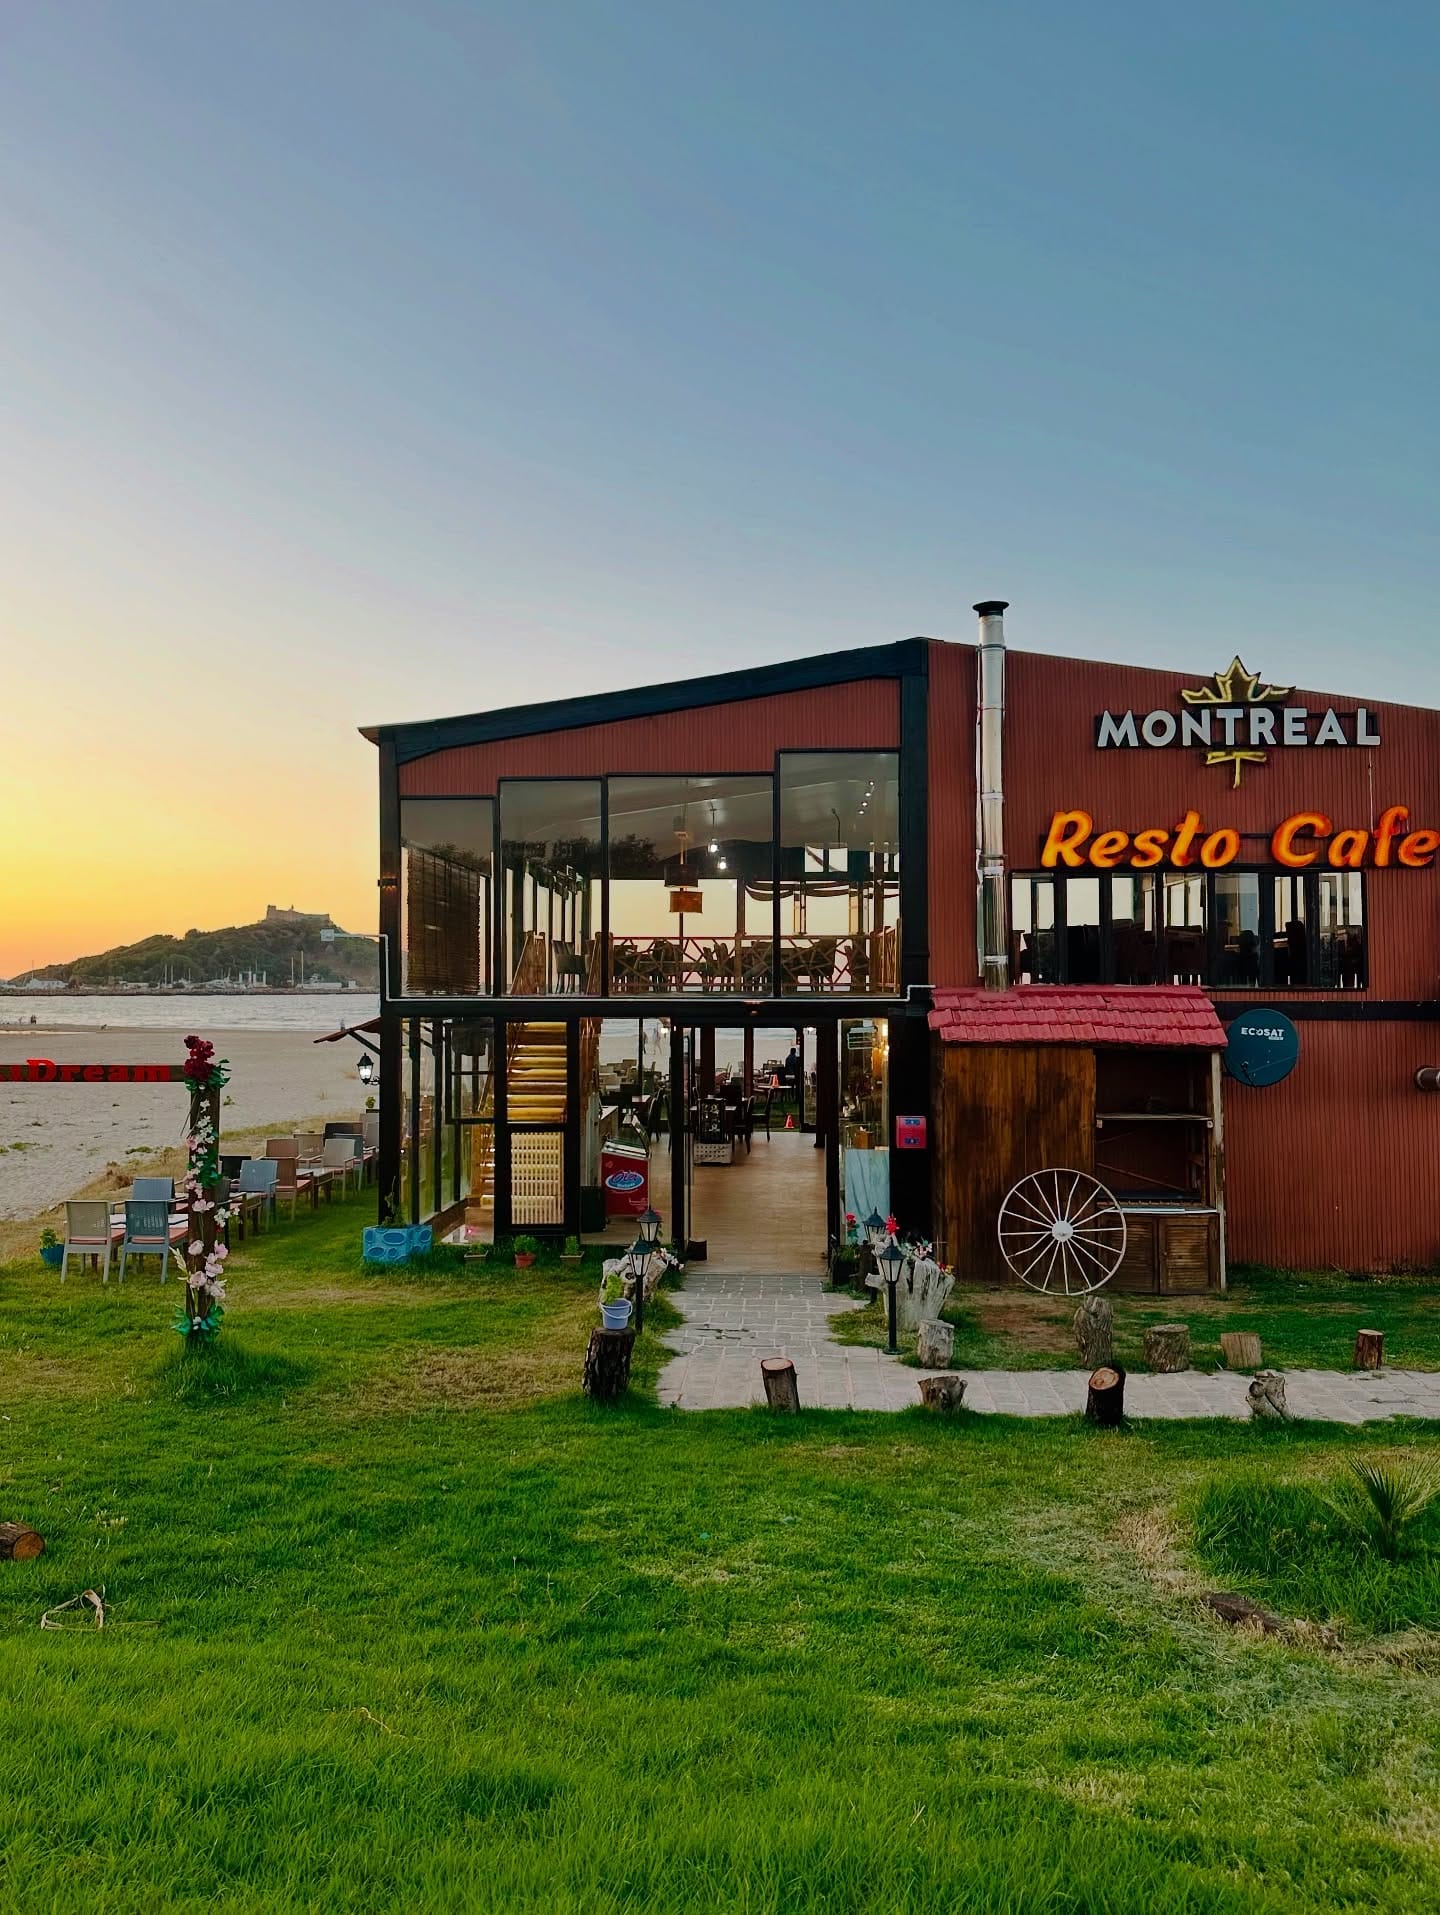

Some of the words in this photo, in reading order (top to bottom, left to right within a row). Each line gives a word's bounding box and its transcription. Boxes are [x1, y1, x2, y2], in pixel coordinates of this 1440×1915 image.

[1097, 707, 1381, 747] MONTREAL
[1040, 809, 1240, 868] Resto
[1271, 805, 1440, 868] Cafe
[1241, 1027, 1284, 1037] ECOSAT
